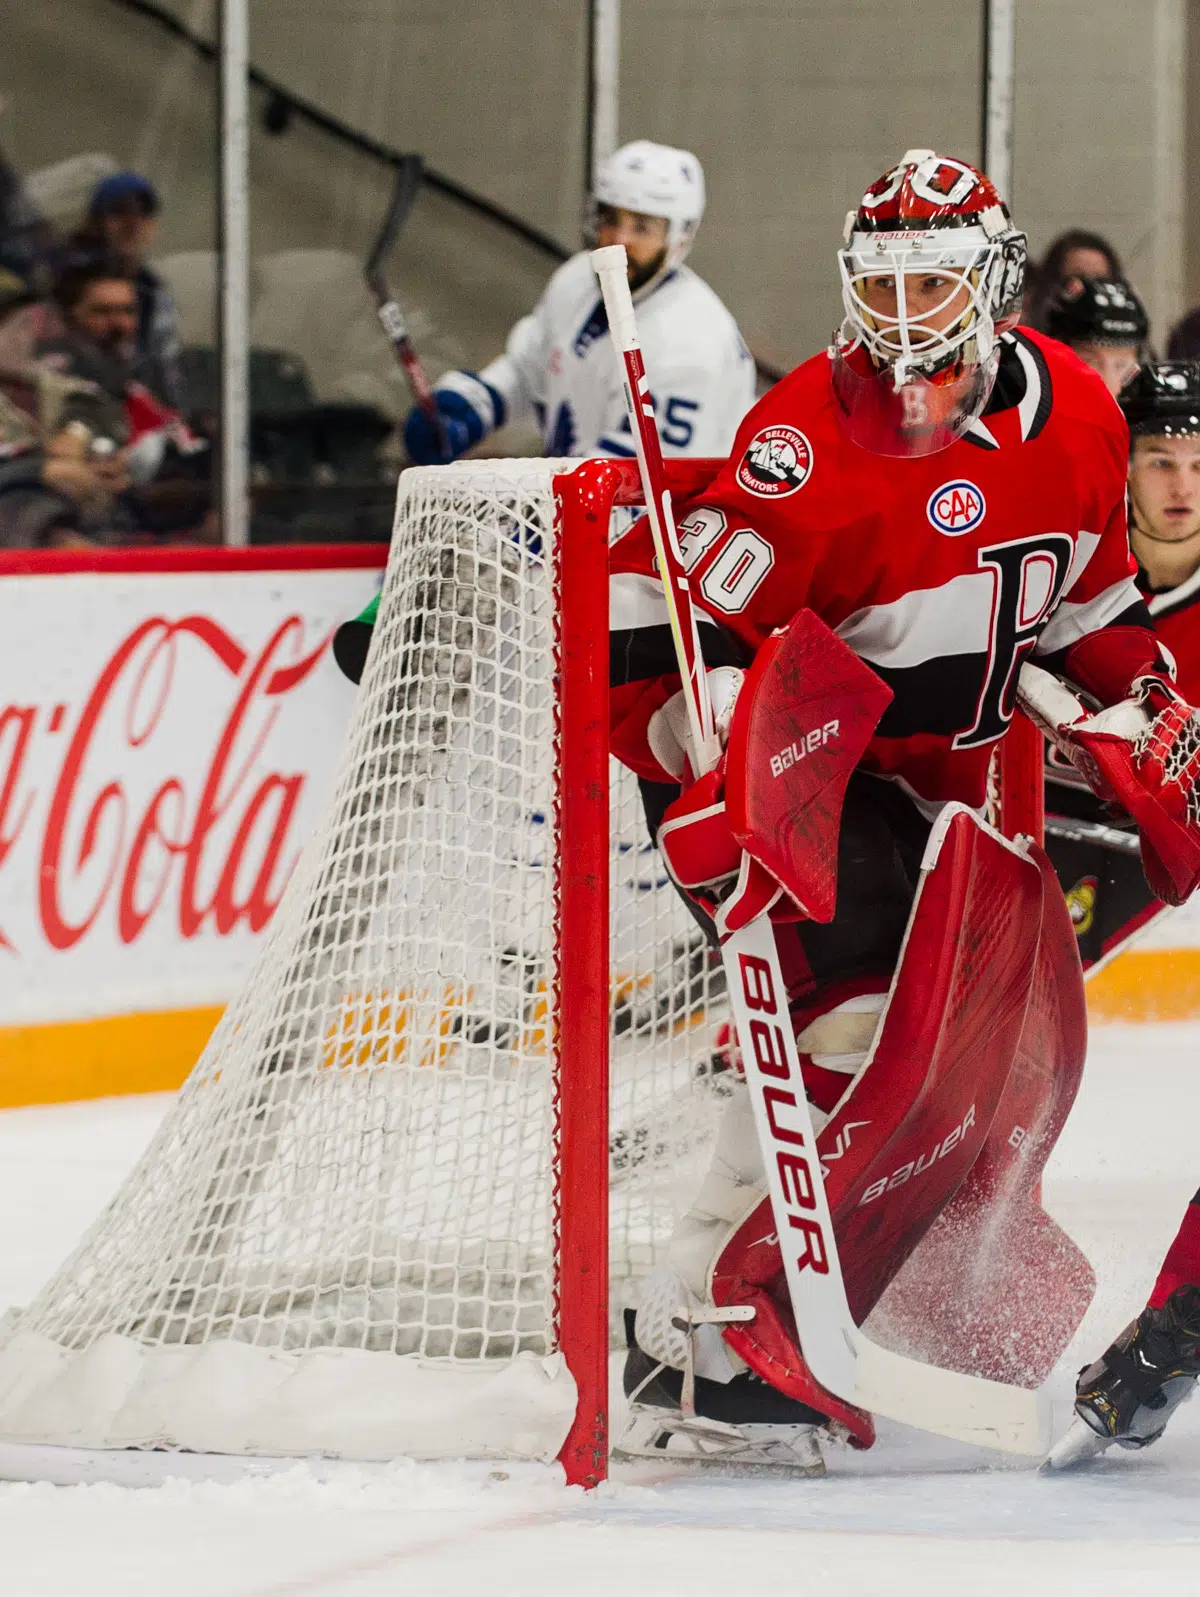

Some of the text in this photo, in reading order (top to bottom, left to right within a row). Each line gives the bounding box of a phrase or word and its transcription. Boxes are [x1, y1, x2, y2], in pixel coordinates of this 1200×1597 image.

[765, 430, 808, 459] BELLEVILLE
[740, 467, 779, 493] SENATORS
[936, 489, 979, 527] CAA
